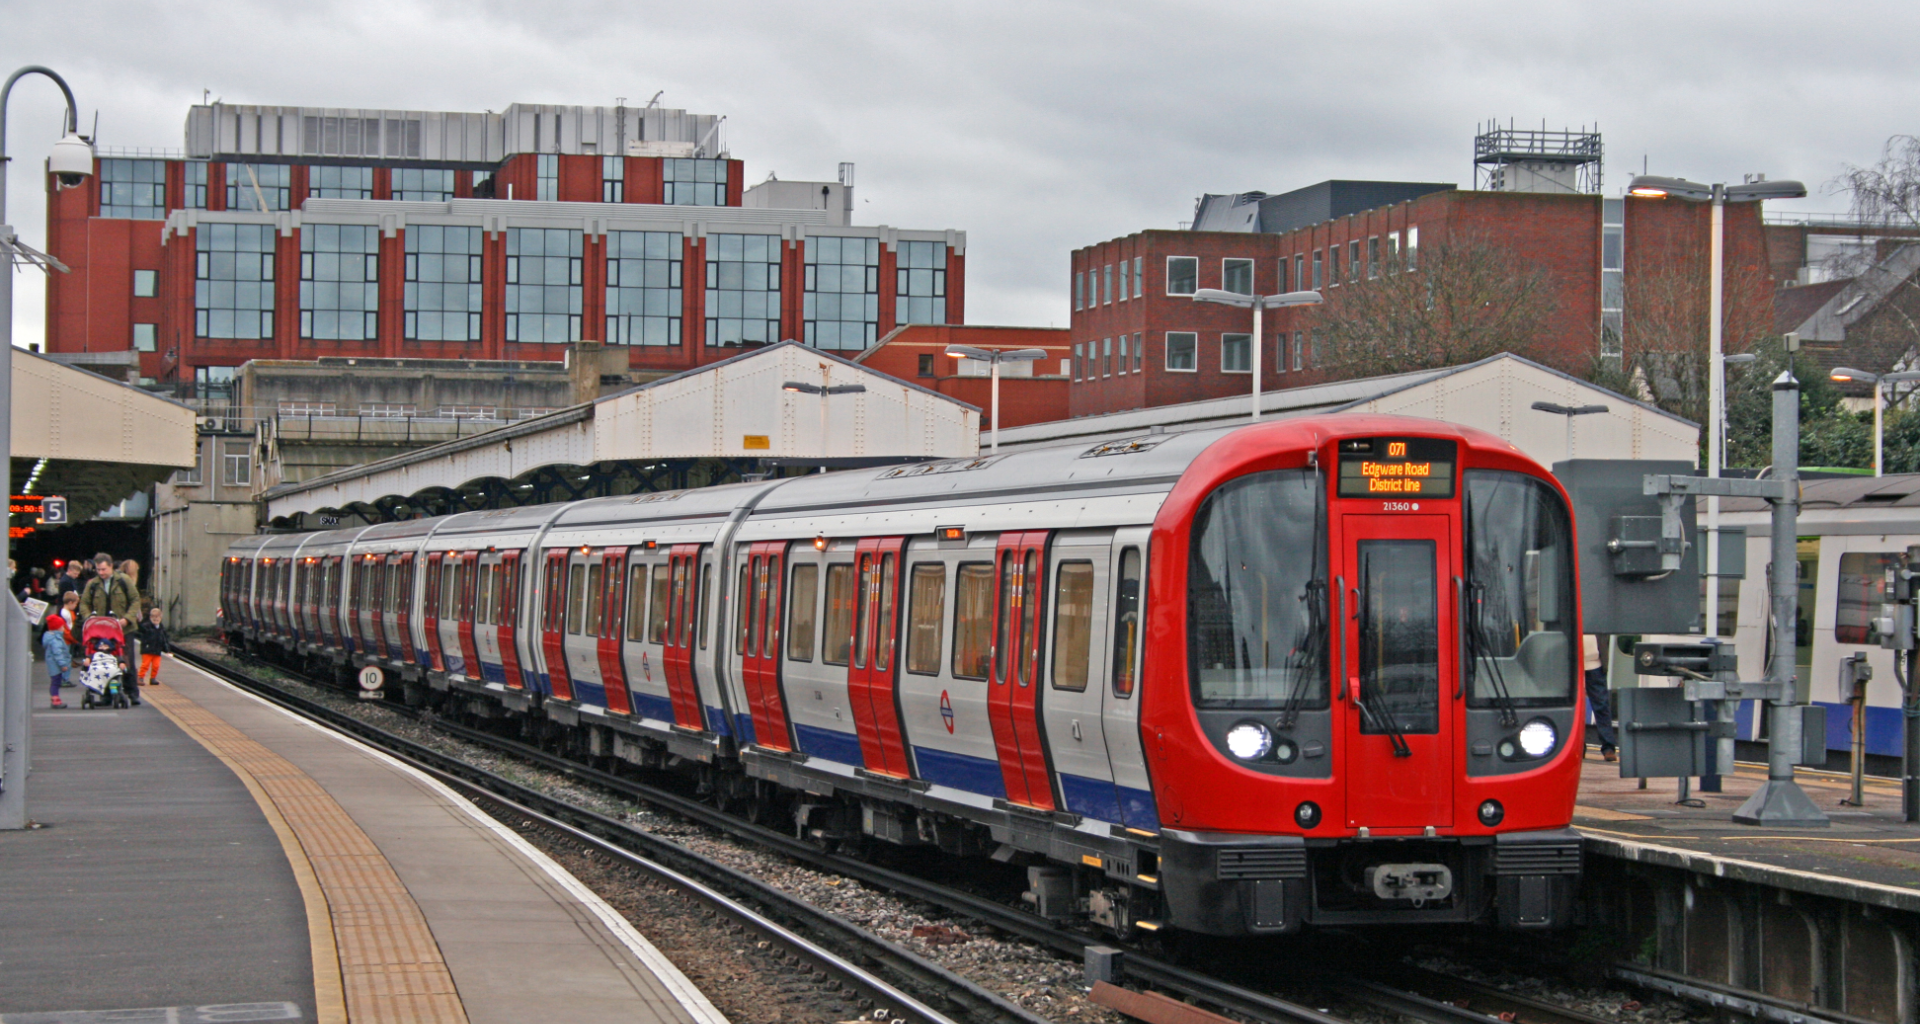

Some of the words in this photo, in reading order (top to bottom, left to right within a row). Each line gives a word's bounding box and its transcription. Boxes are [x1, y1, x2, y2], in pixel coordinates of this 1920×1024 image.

[1388, 442, 1407, 456] 071
[1362, 462, 1403, 477] Edgware
[1405, 462, 1430, 476] Road
[1369, 478, 1402, 492] District
[1404, 478, 1421, 492] line
[49, 503, 61, 520] 5
[1383, 502, 1409, 511] 21360
[365, 672, 377, 684] 10
